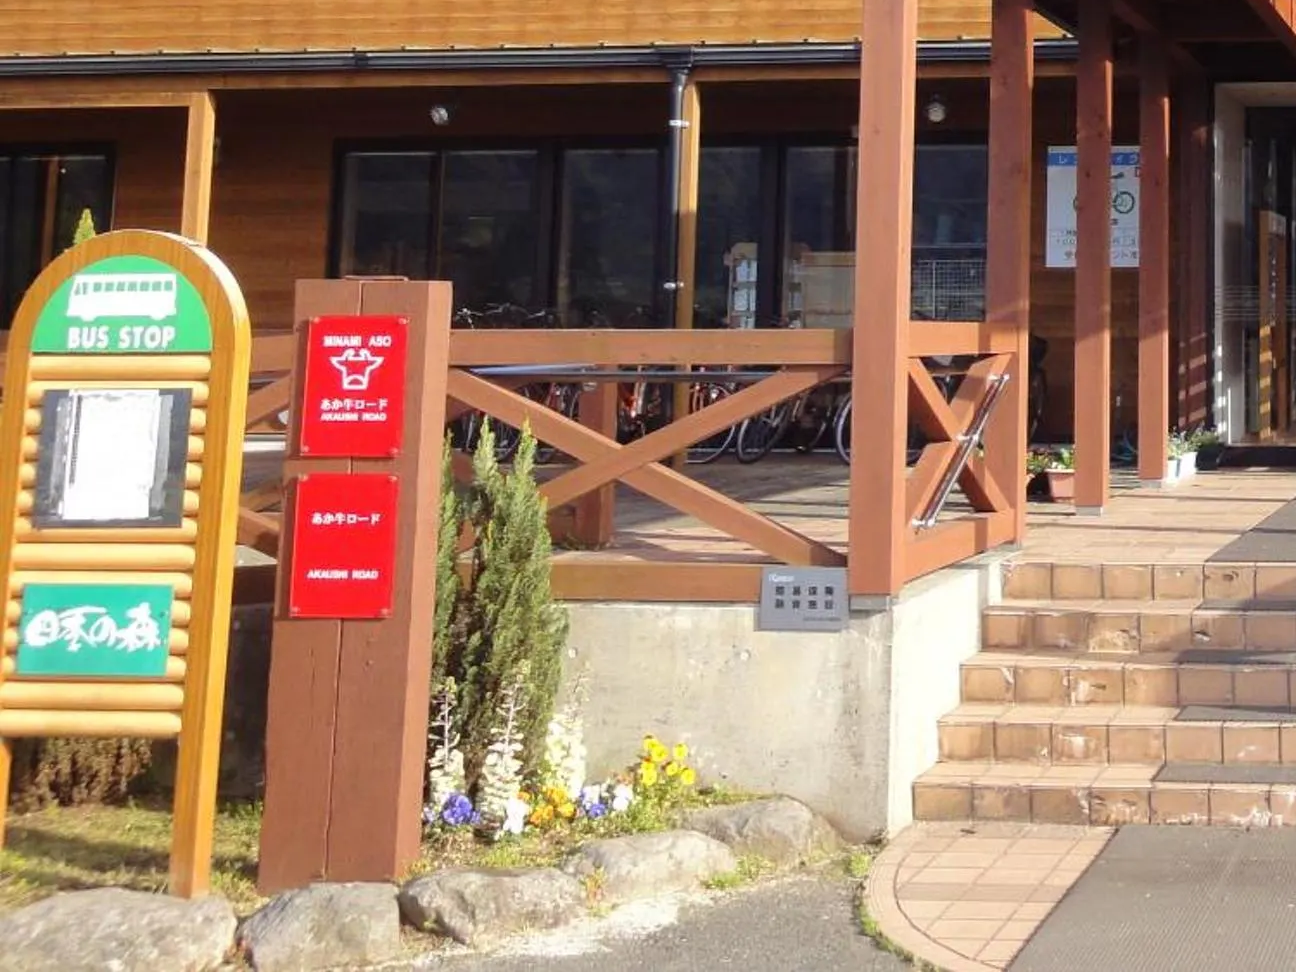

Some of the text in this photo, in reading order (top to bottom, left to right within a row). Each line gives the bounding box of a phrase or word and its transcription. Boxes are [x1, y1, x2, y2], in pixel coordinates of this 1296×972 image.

[68, 325, 175, 350] BUS STOP
[323, 335, 392, 347] MINAMI ASO
[320, 398, 388, 411] あか牛ロード
[311, 511, 381, 526] あか牛ロード
